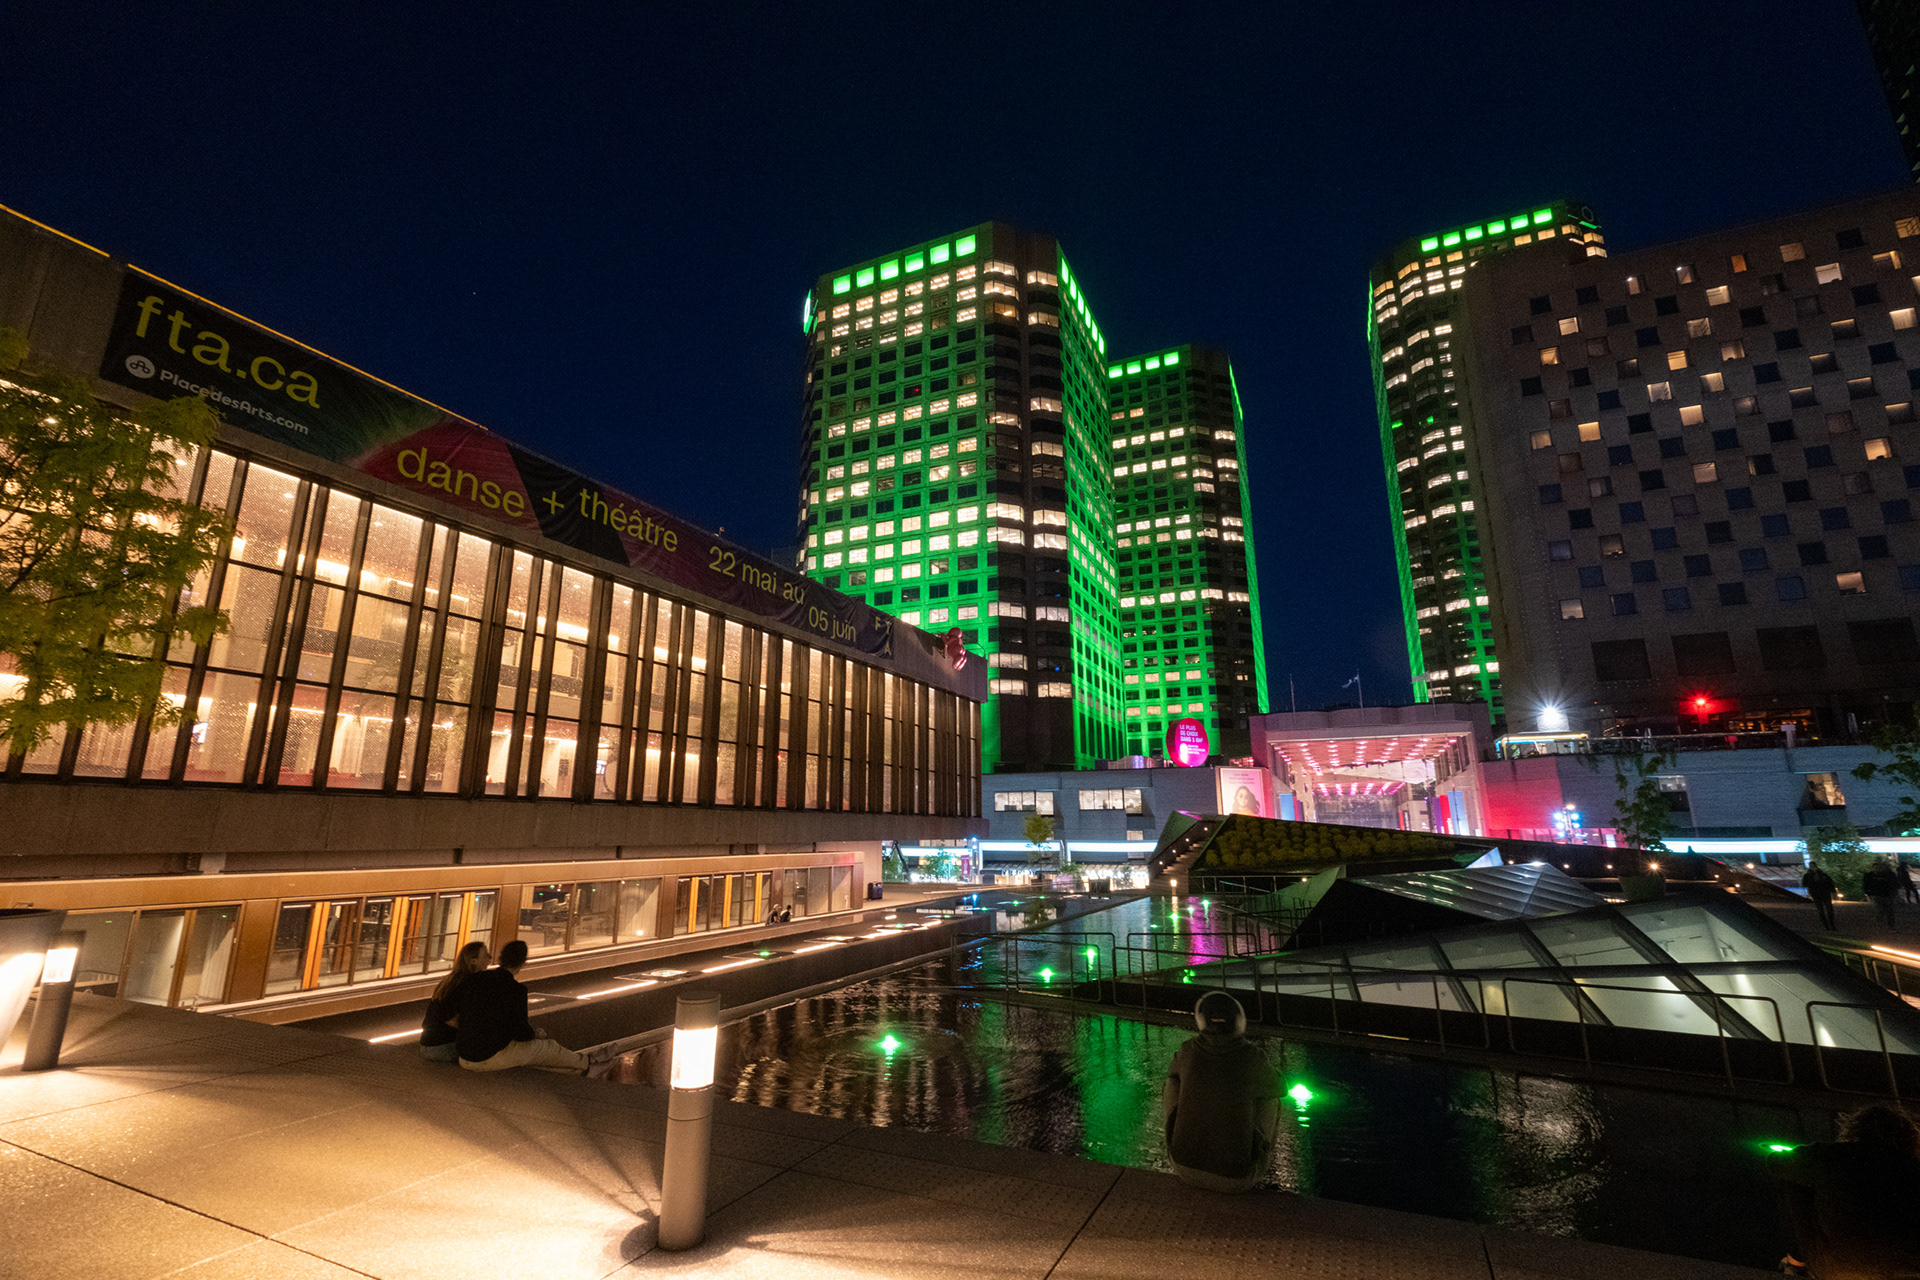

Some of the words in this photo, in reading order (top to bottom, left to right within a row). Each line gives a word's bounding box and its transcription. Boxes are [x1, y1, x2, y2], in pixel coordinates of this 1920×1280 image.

[135, 295, 320, 409] fta.ca
[159, 369, 309, 435] PlacedesArts.com
[397, 447, 525, 517] danse
[579, 488, 678, 551] théâtre
[709, 545, 736, 578] 22
[742, 562, 777, 595] mai
[782, 581, 805, 605] au
[808, 605, 829, 632] 05
[830, 614, 857, 643] juin
